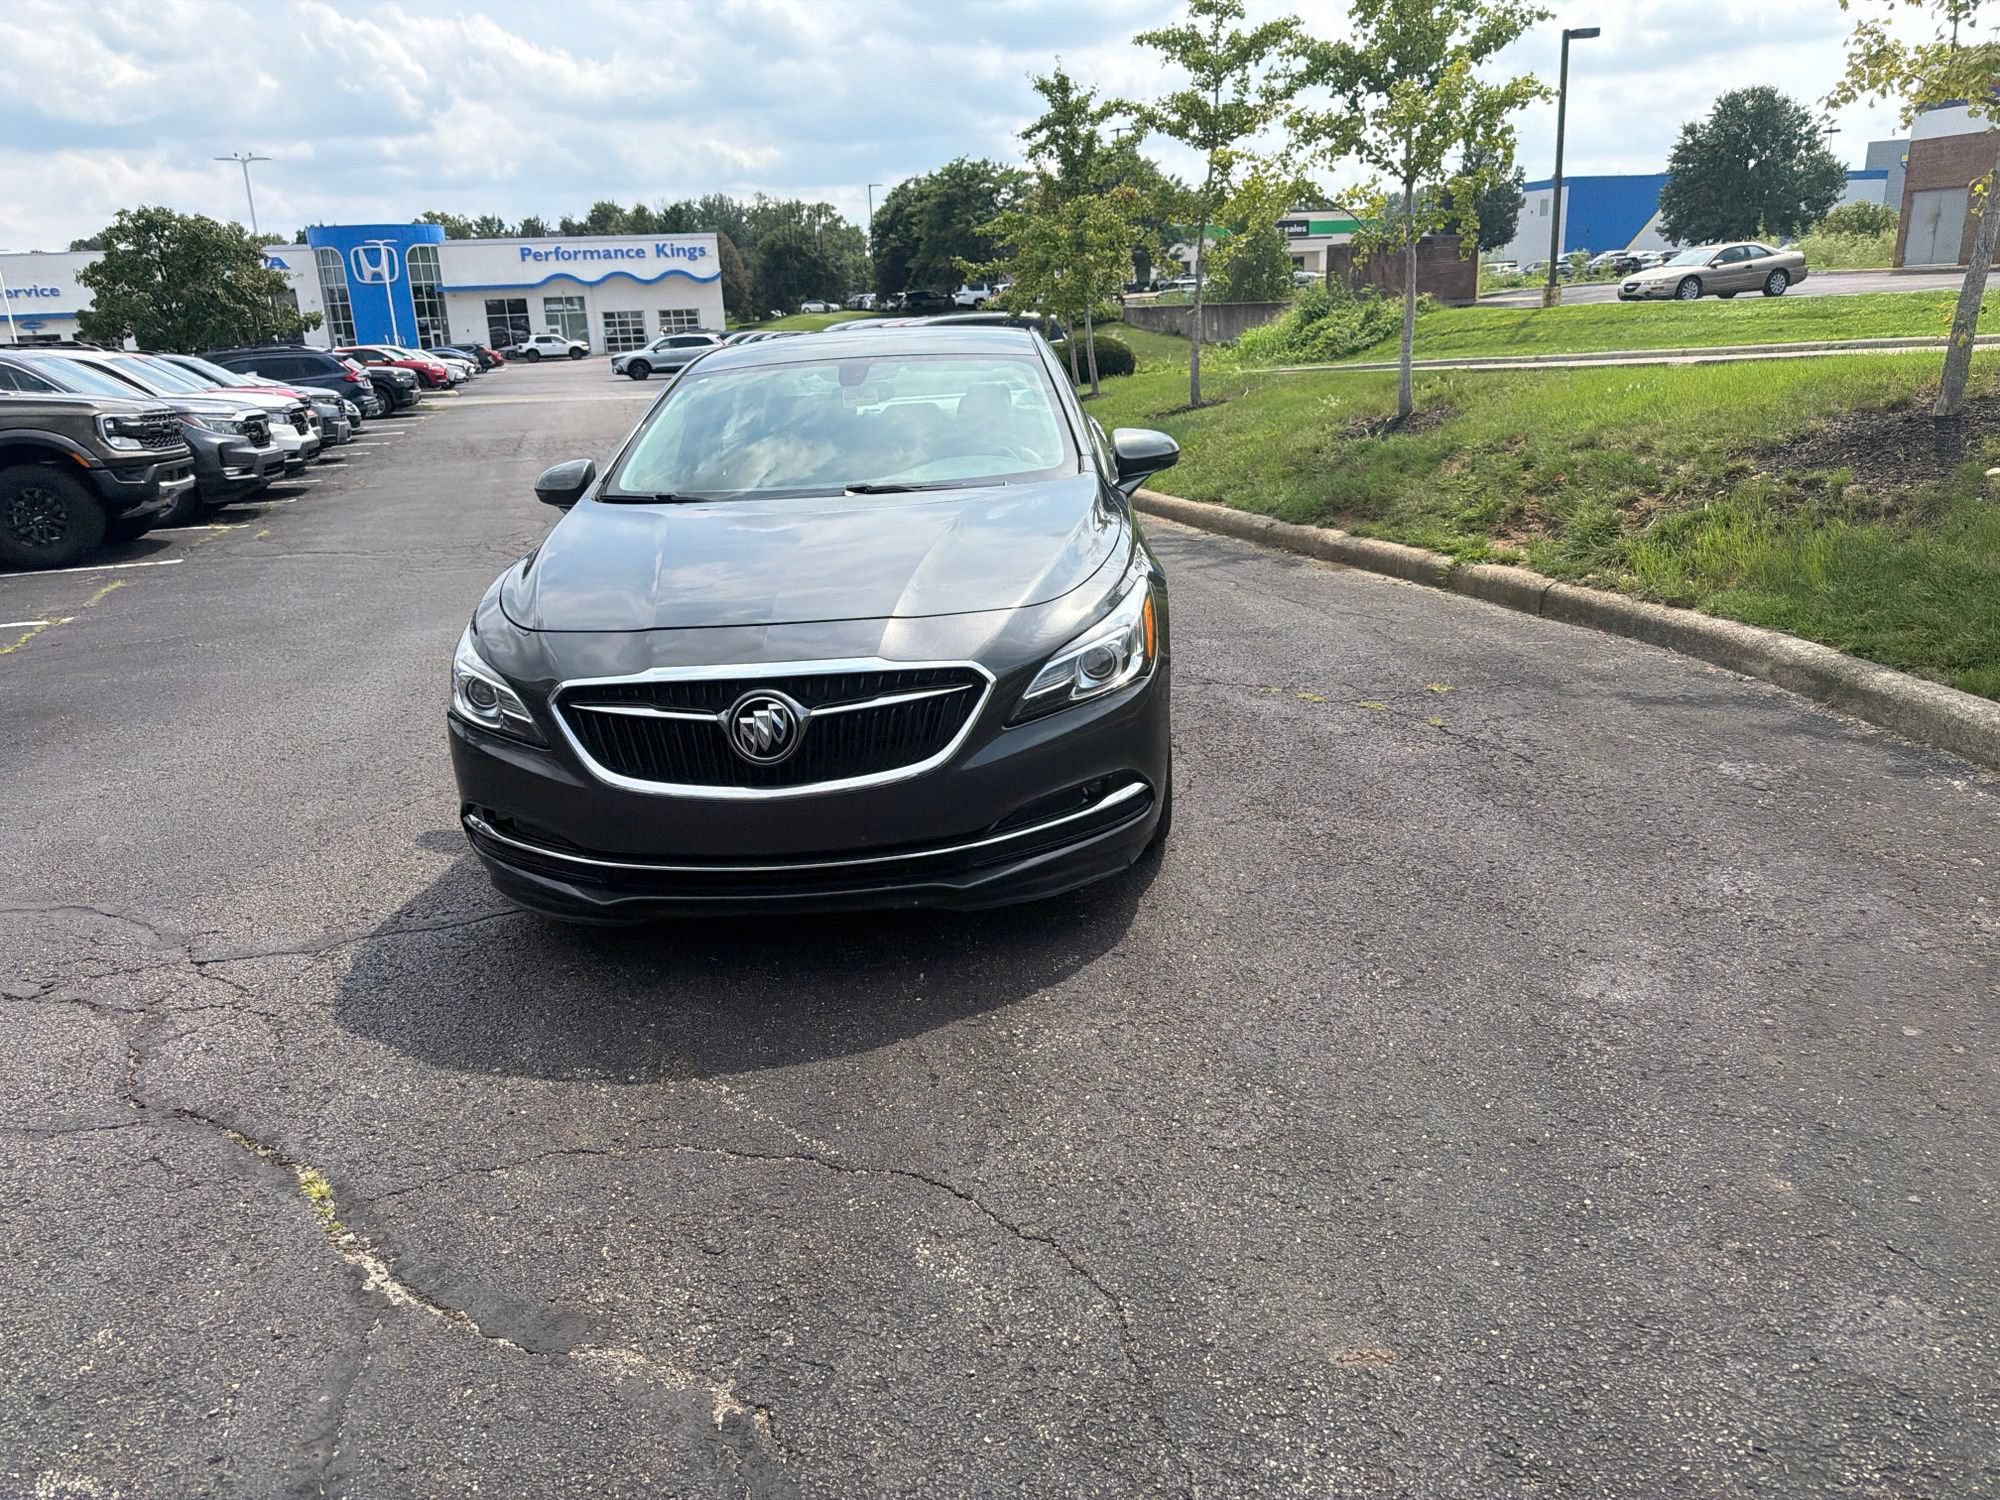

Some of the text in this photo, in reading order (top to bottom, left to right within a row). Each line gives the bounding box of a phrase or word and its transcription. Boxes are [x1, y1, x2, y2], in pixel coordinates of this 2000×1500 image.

[520, 243, 706, 262] Performance Kings
[0, 284, 60, 298] ervice
